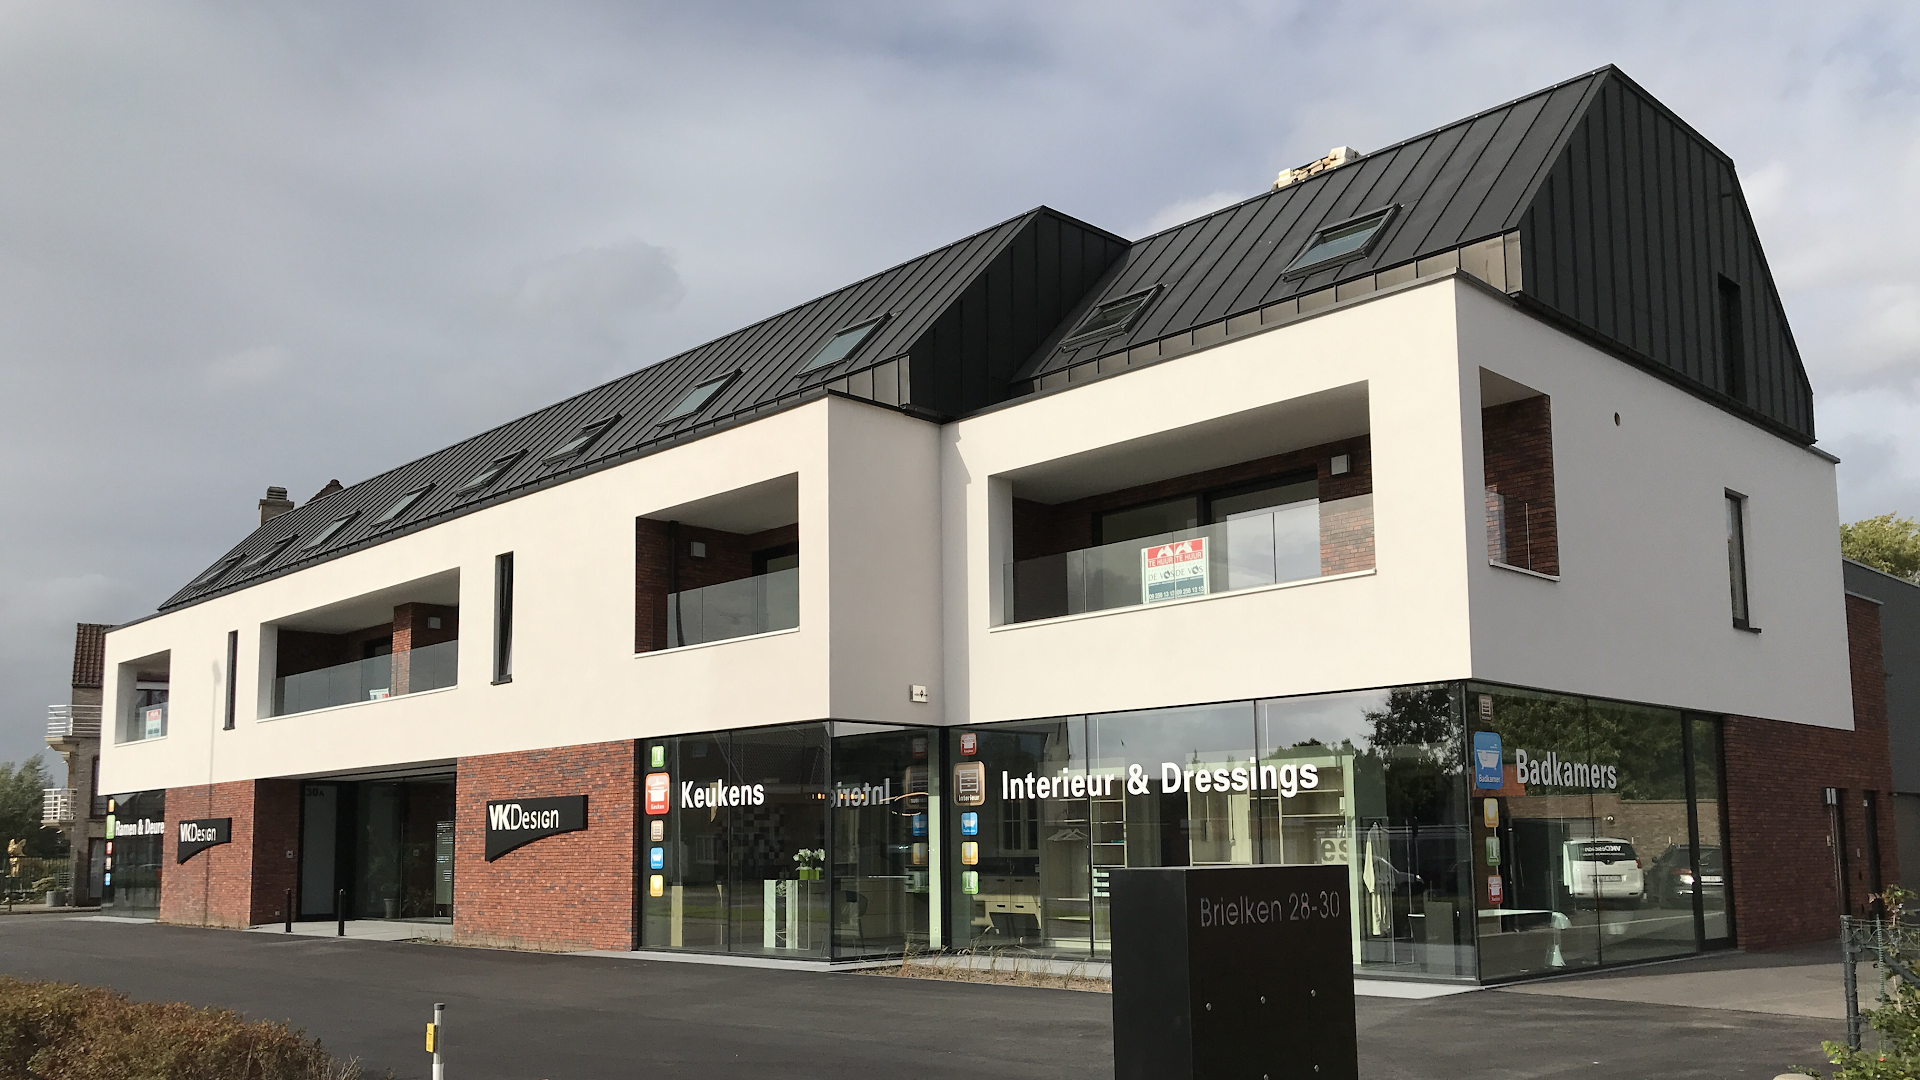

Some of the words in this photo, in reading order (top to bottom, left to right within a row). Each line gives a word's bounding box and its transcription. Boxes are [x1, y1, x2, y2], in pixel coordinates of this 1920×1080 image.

[1157, 557, 1173, 565] HUUR
[1185, 552, 1201, 560] HUUR
[1001, 767, 1115, 800] Interieur
[1126, 763, 1150, 796] &
[1161, 756, 1319, 799] Dressings
[1515, 748, 1617, 790] Badkamers
[681, 778, 765, 809] Keukens
[115, 820, 137, 837] Ramen
[138, 818, 144, 837] &
[1200, 895, 1282, 927] Brielken
[1288, 890, 1340, 921] 28-30
